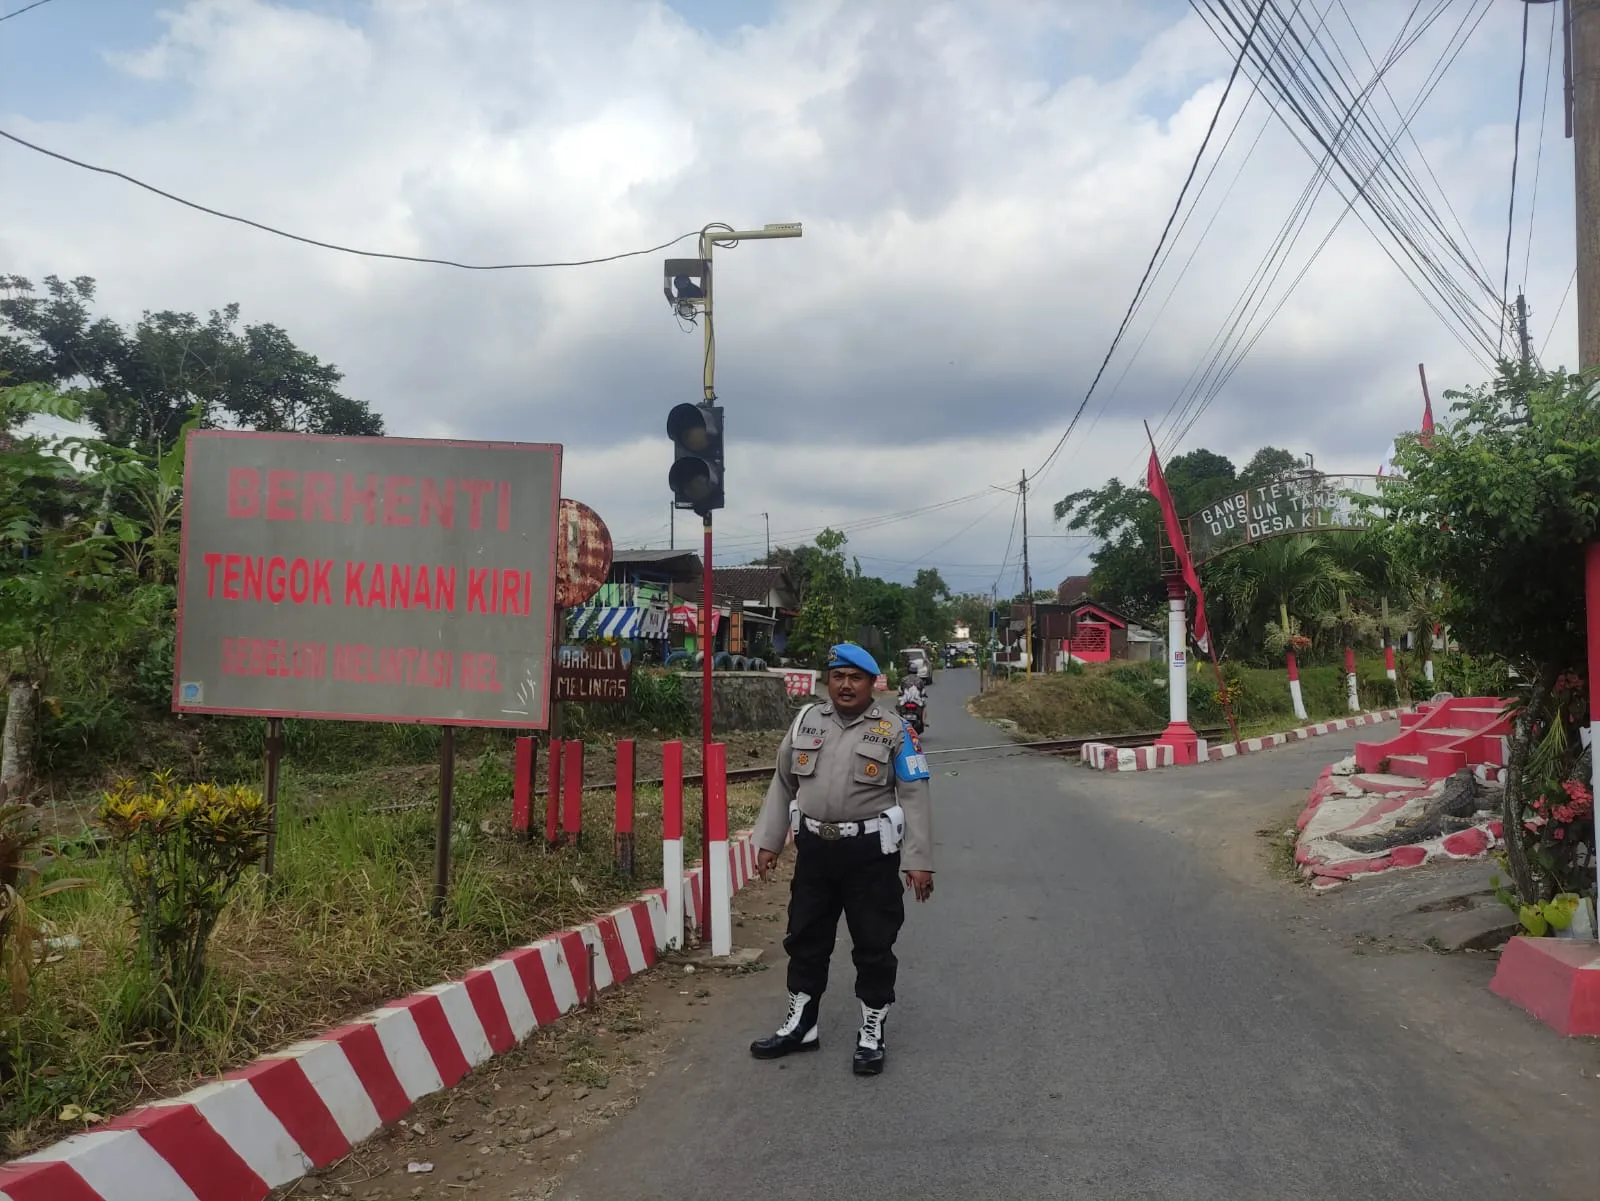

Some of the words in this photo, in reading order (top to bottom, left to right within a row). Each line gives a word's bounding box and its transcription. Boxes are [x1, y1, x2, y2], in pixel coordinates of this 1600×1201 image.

[227, 467, 513, 532] BERHENTI
[1202, 495, 1246, 524] GANG
[1211, 500, 1278, 537] DUSUN
[1249, 515, 1295, 538] DESA
[204, 552, 334, 606] TENGOK
[345, 561, 457, 613] KANAN
[467, 568, 532, 617] KIRI
[221, 636, 326, 680] SEBELUM
[333, 643, 453, 688] MELINTASI
[461, 650, 504, 693] REL
[557, 677, 627, 697] MELINTAS
[862, 734, 893, 746] POLRI
